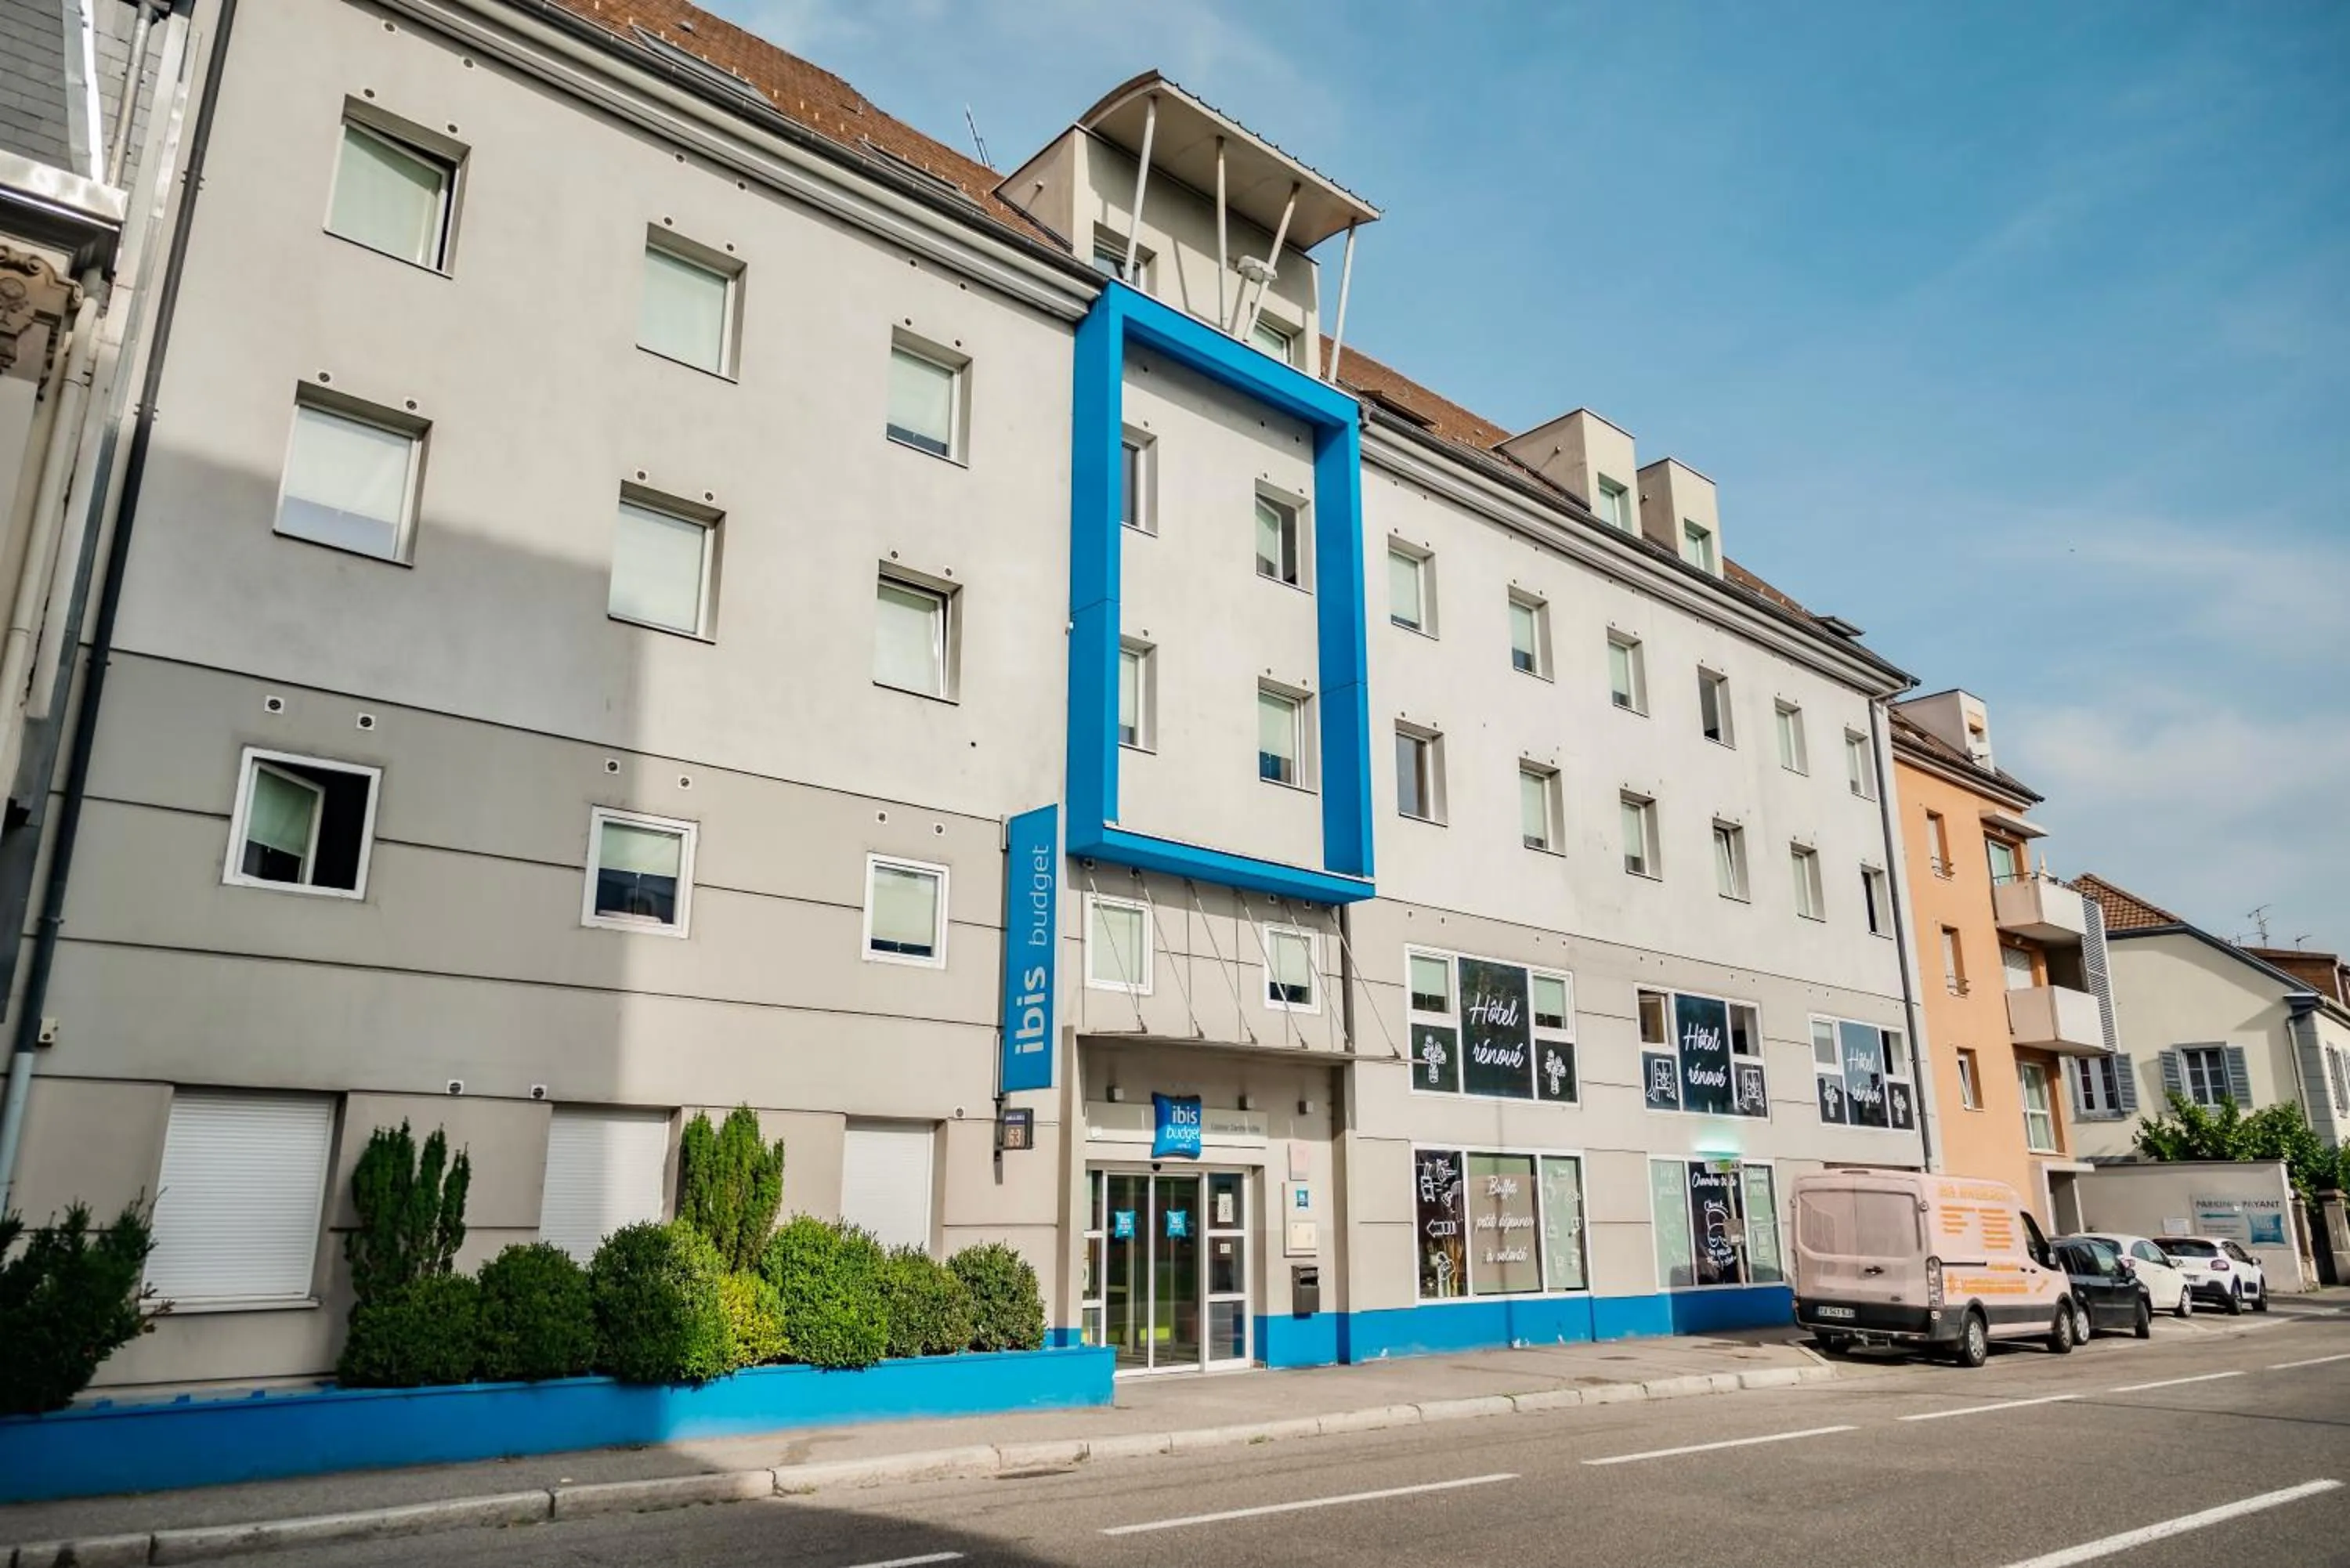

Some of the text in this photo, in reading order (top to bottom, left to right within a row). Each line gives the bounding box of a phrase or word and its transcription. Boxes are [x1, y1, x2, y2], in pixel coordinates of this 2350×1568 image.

[1015, 844, 1053, 1055] ibis budget
[1469, 992, 1519, 1027] Hôtel
[1683, 1022, 1721, 1052] Hôtel
[1473, 1039, 1524, 1068] rénové
[1687, 1062, 1726, 1088] rénové
[1172, 1105, 1198, 1125] ibis
[2195, 1199, 2238, 1208] PARKIN
